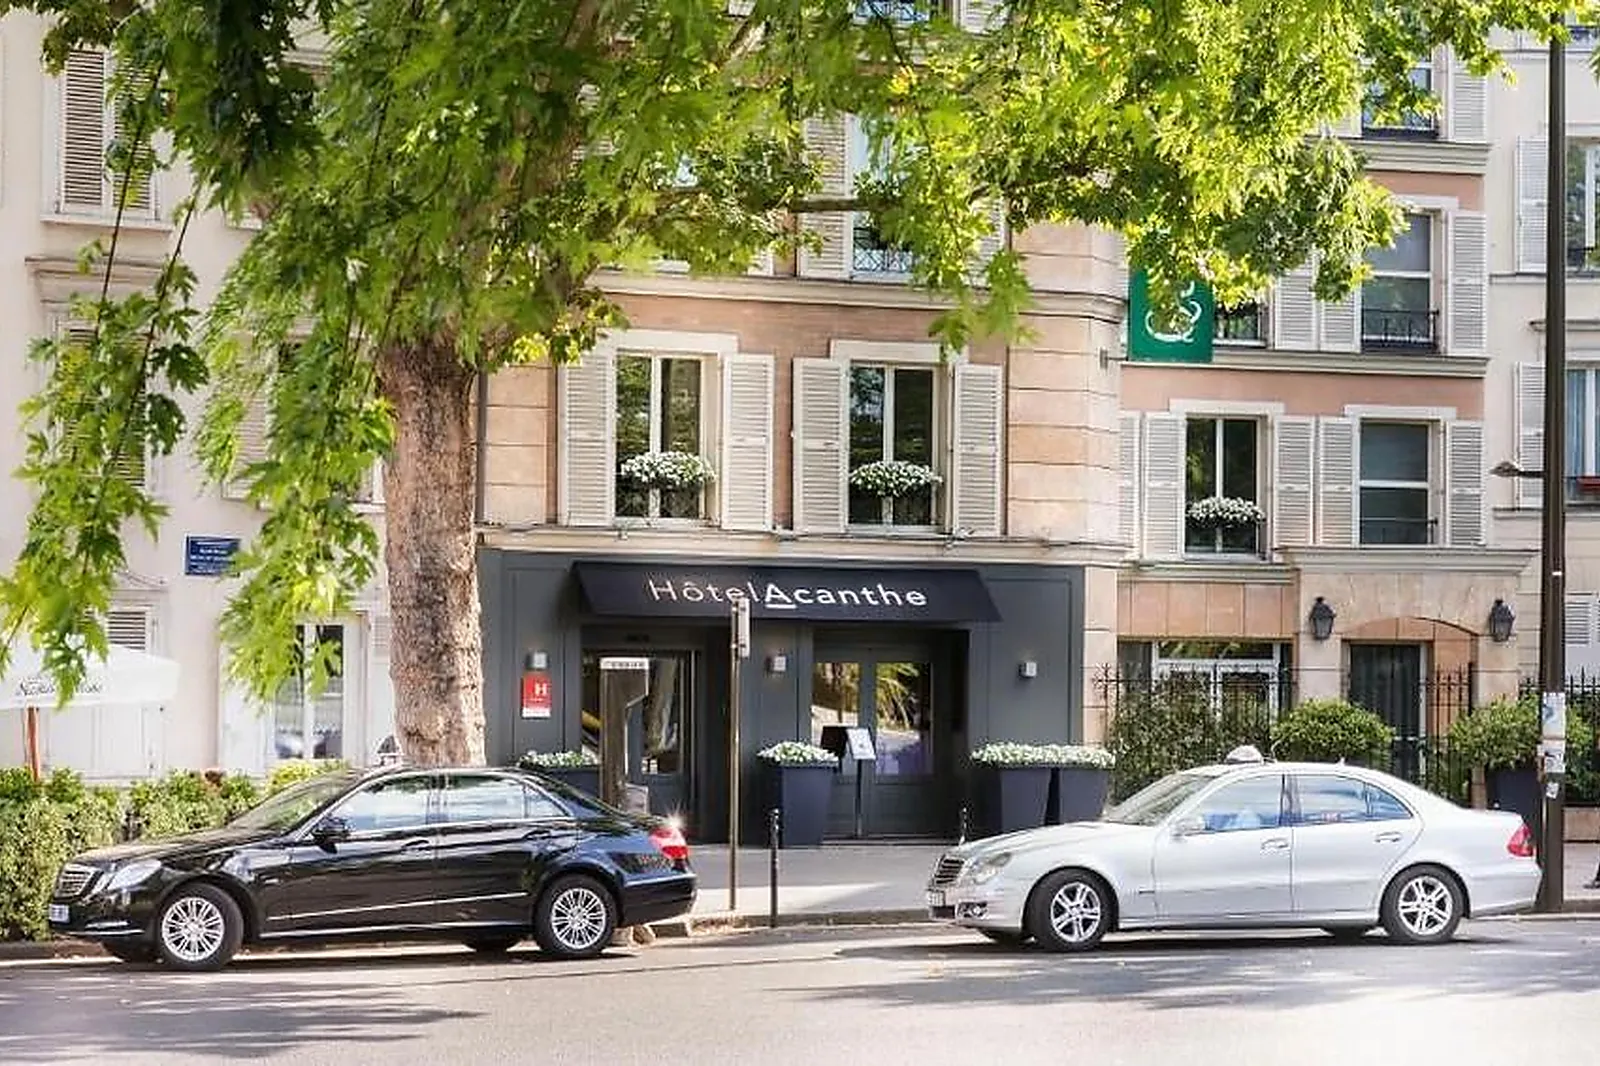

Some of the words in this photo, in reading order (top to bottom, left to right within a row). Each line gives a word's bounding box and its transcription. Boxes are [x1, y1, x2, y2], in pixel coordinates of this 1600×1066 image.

[648, 580, 760, 602] Hôtel
[764, 583, 928, 608] Acanthe
[534, 682, 548, 696] H
